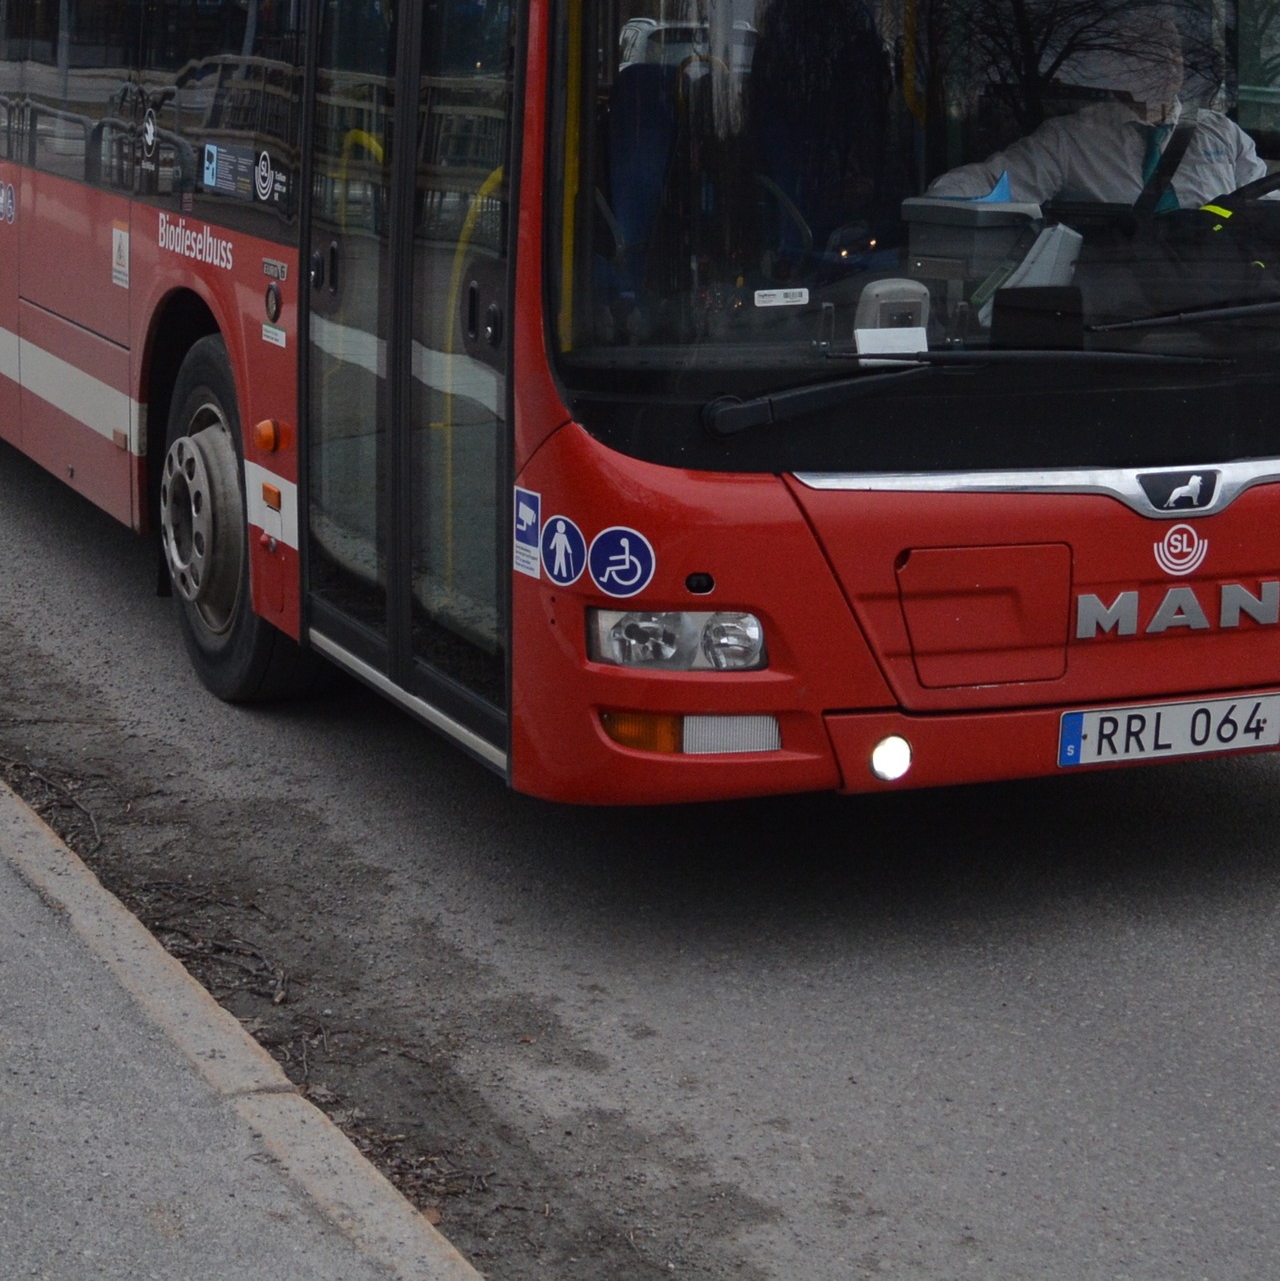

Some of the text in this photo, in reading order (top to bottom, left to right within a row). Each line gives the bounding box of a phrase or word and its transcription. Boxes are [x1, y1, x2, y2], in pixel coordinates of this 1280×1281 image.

[261, 160, 268, 177] SL
[158, 212, 234, 270] Biodieselbuss
[1170, 533, 1193, 554] SL
[1076, 581, 1280, 639] MAN
[1096, 702, 1265, 757] RRL 064
